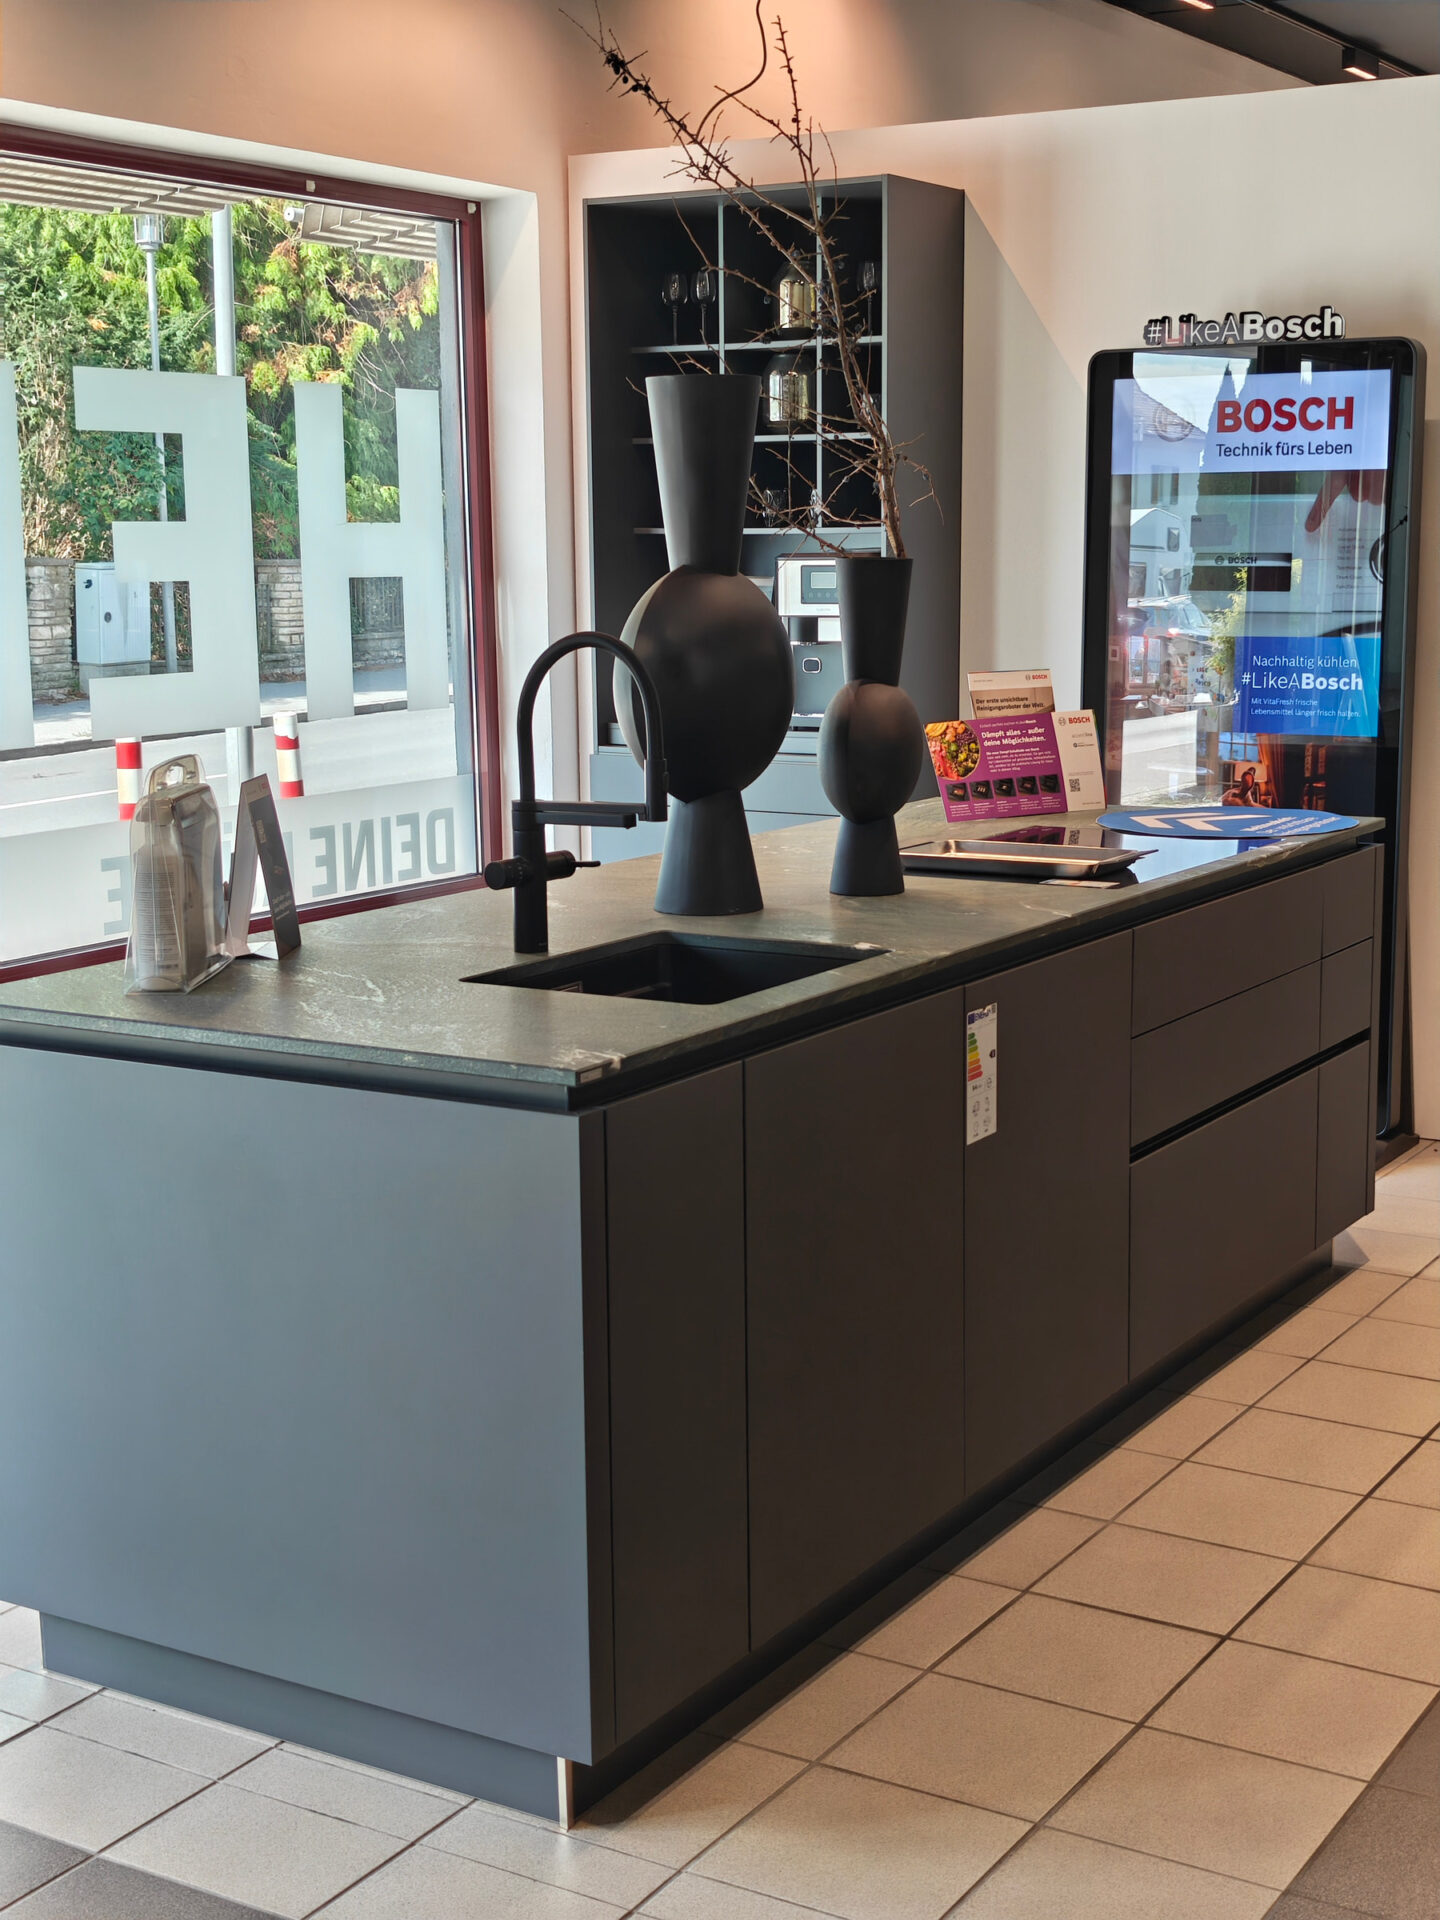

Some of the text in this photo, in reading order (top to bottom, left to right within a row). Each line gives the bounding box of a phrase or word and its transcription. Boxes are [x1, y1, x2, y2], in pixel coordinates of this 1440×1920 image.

[1146, 307, 1344, 346] #LikeABosch
[1216, 396, 1354, 433] BOSCH
[1216, 441, 1353, 458] Technik fürs Leben
[1228, 556, 1258, 565] BOSCH
[1252, 655, 1358, 669] Nachhaltig kühlen
[1241, 671, 1363, 691] #LikeABosch
[1251, 697, 1318, 706] Mit VitaFresh frische
[1250, 708, 1294, 716] Lebensmittel
[1068, 716, 1091, 725] BOSCH
[981, 730, 1005, 739] Dämpft
[1006, 728, 1021, 736] alles
